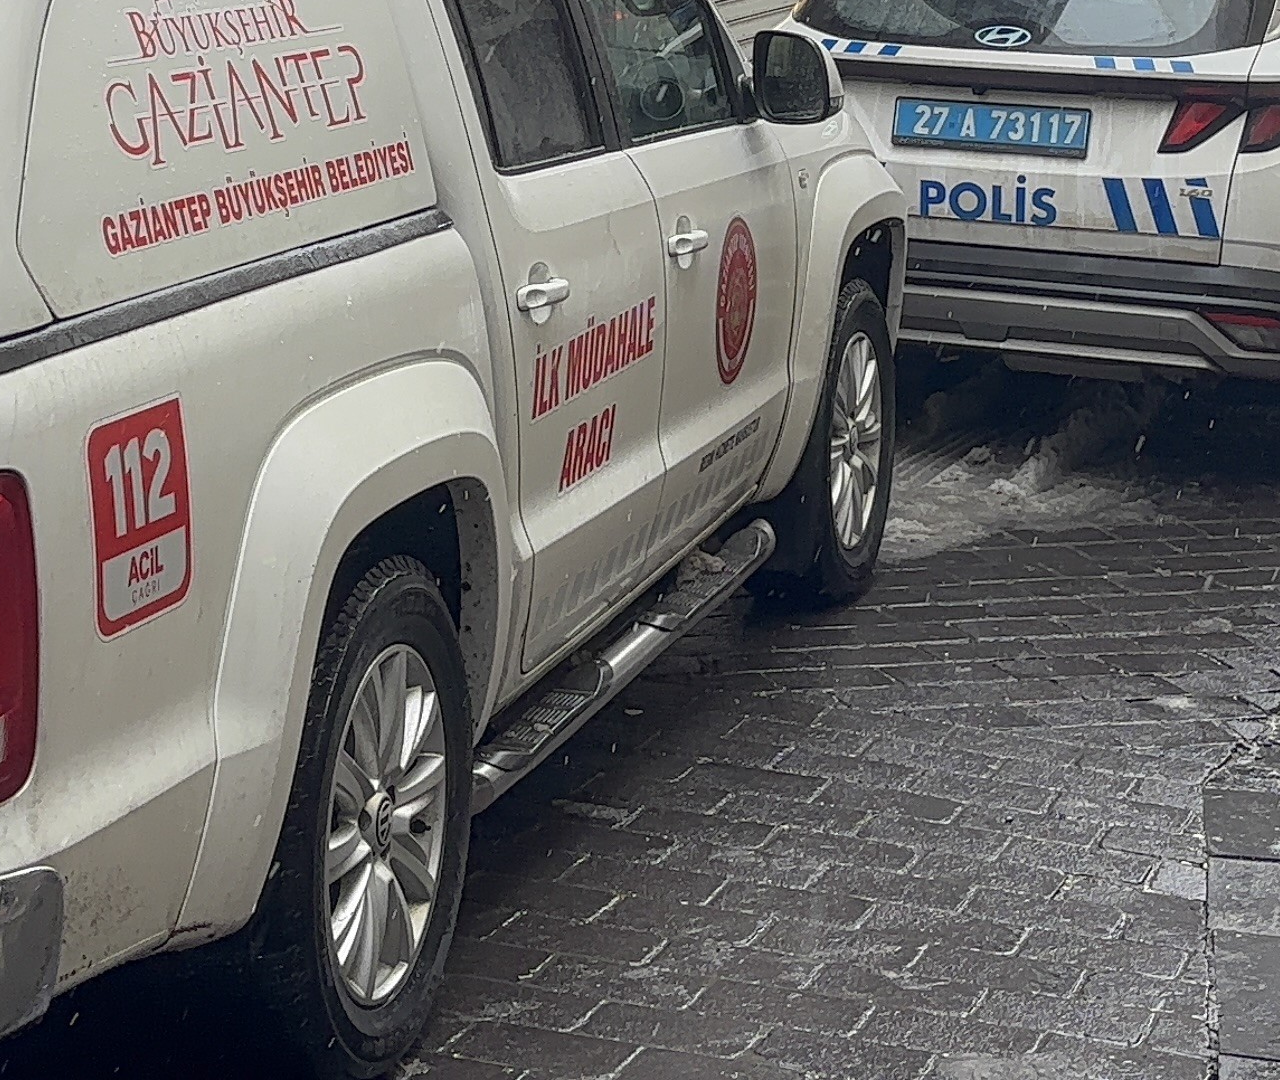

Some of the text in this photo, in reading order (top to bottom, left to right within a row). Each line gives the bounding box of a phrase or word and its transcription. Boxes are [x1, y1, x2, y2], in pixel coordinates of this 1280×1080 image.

[105, 44, 366, 166] GAZİANTEP
[911, 104, 1082, 145] 27 A 73117
[102, 131, 415, 256] GAZİANTEP BÜYÜKŞEHİR BELEDİYESİ
[920, 175, 1058, 226] POLİS
[531, 295, 656, 420] İLK MÜDAHALE
[103, 427, 177, 538] 112
[558, 403, 617, 493] ARACI
